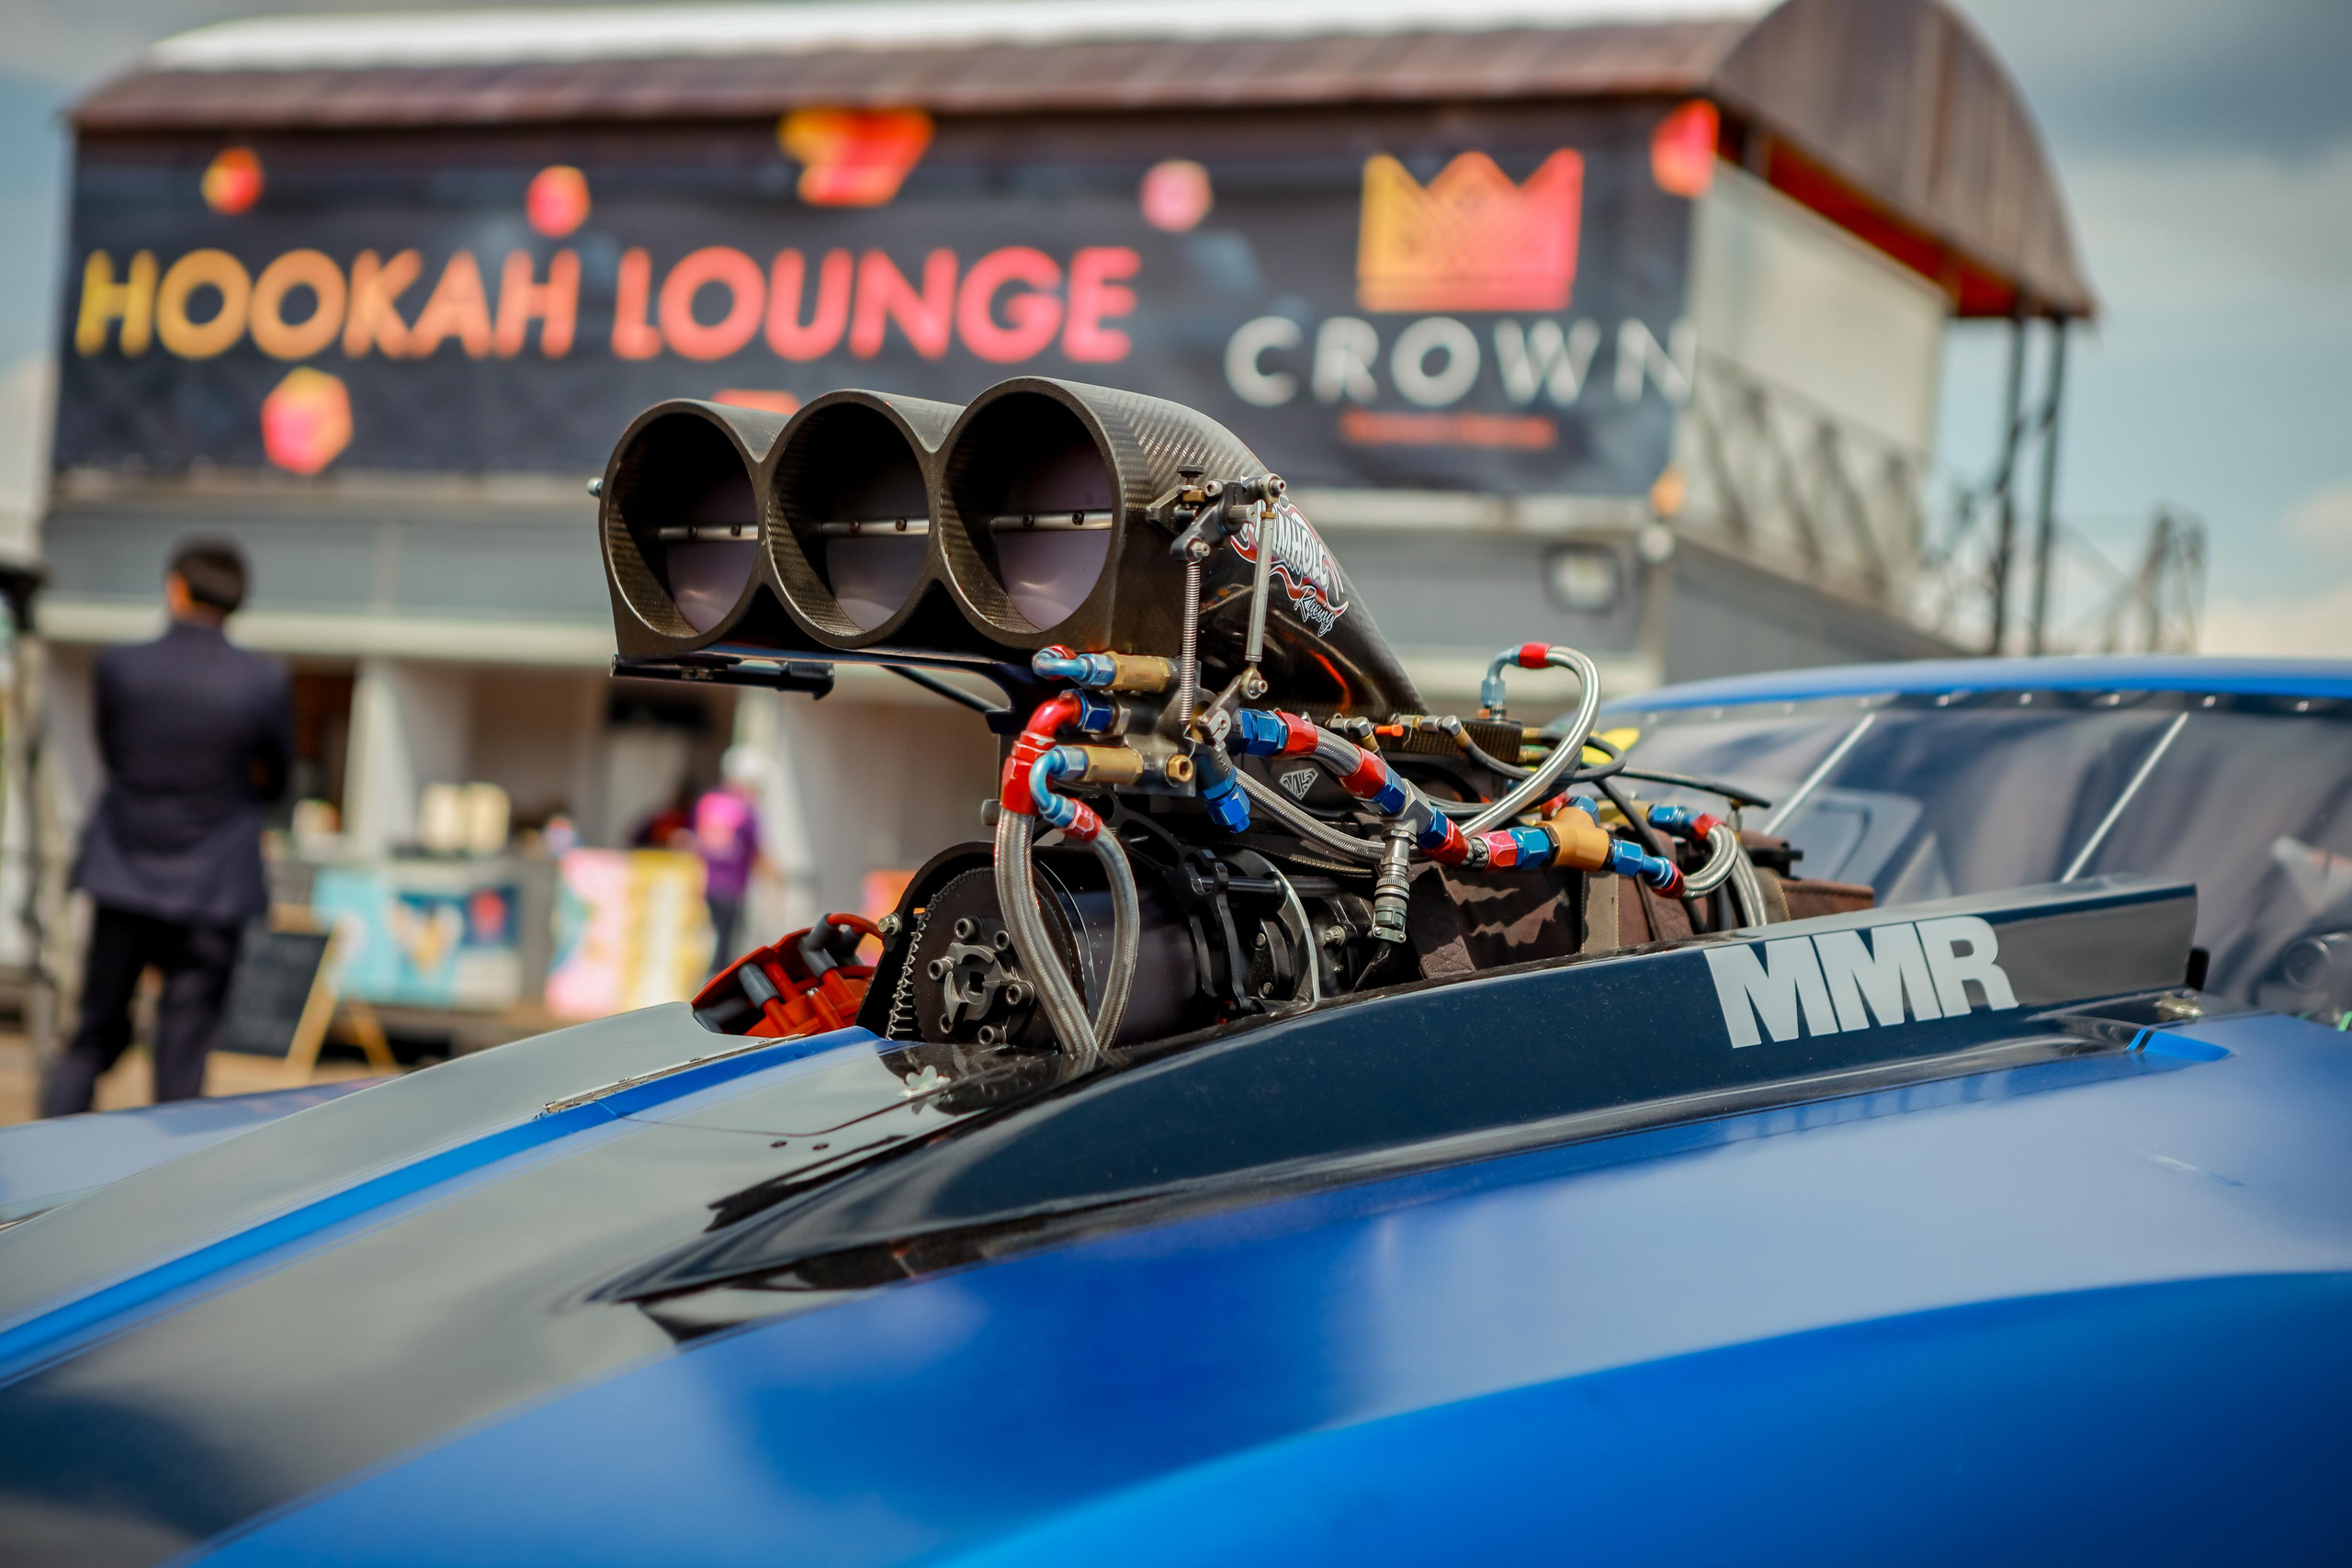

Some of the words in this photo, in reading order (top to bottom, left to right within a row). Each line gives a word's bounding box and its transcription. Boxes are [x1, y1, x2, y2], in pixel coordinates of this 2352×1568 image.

[74, 247, 581, 360] HOOKAH
[610, 244, 1142, 364] LOUNGE
[1224, 316, 1698, 408] CROWN
[1294, 585, 1335, 637] Racing
[1702, 916, 2019, 1049] MMR
